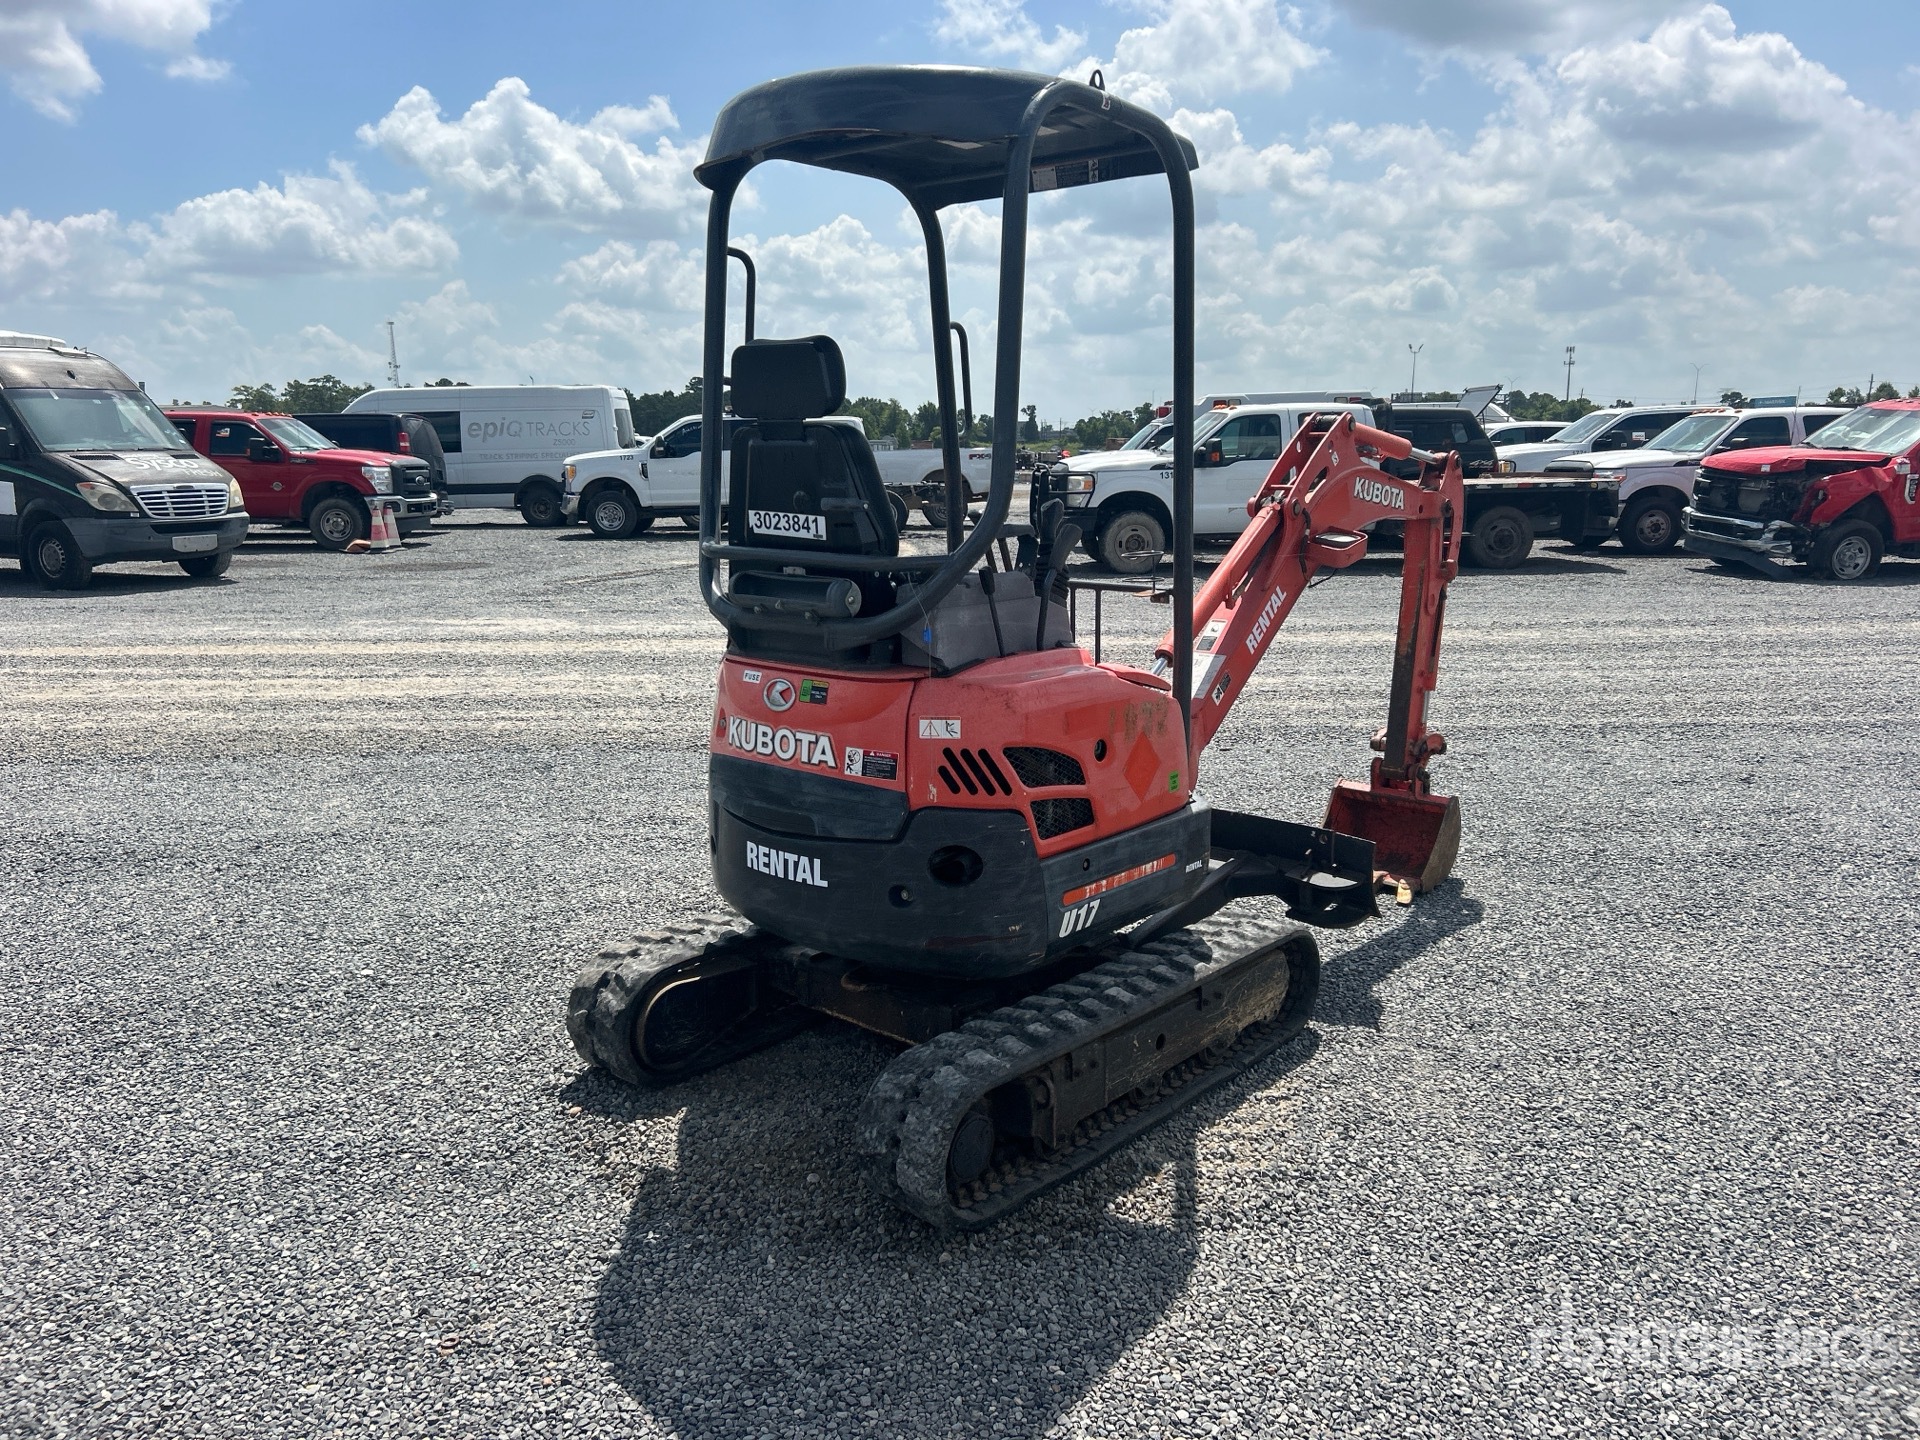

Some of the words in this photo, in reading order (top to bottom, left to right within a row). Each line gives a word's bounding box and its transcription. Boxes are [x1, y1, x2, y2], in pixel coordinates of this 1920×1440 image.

[526, 421, 590, 437] TRACKS
[182, 468, 223, 478] FRESH
[1354, 476, 1405, 511] KUBOTA
[754, 511, 820, 535] 3023841
[1245, 585, 1288, 655] RENTAL
[745, 672, 761, 682] FUSE
[728, 715, 839, 768] KUBOTA
[746, 840, 829, 888] RENTAL
[1185, 859, 1203, 873] RENTAL
[1058, 898, 1101, 938] U17
